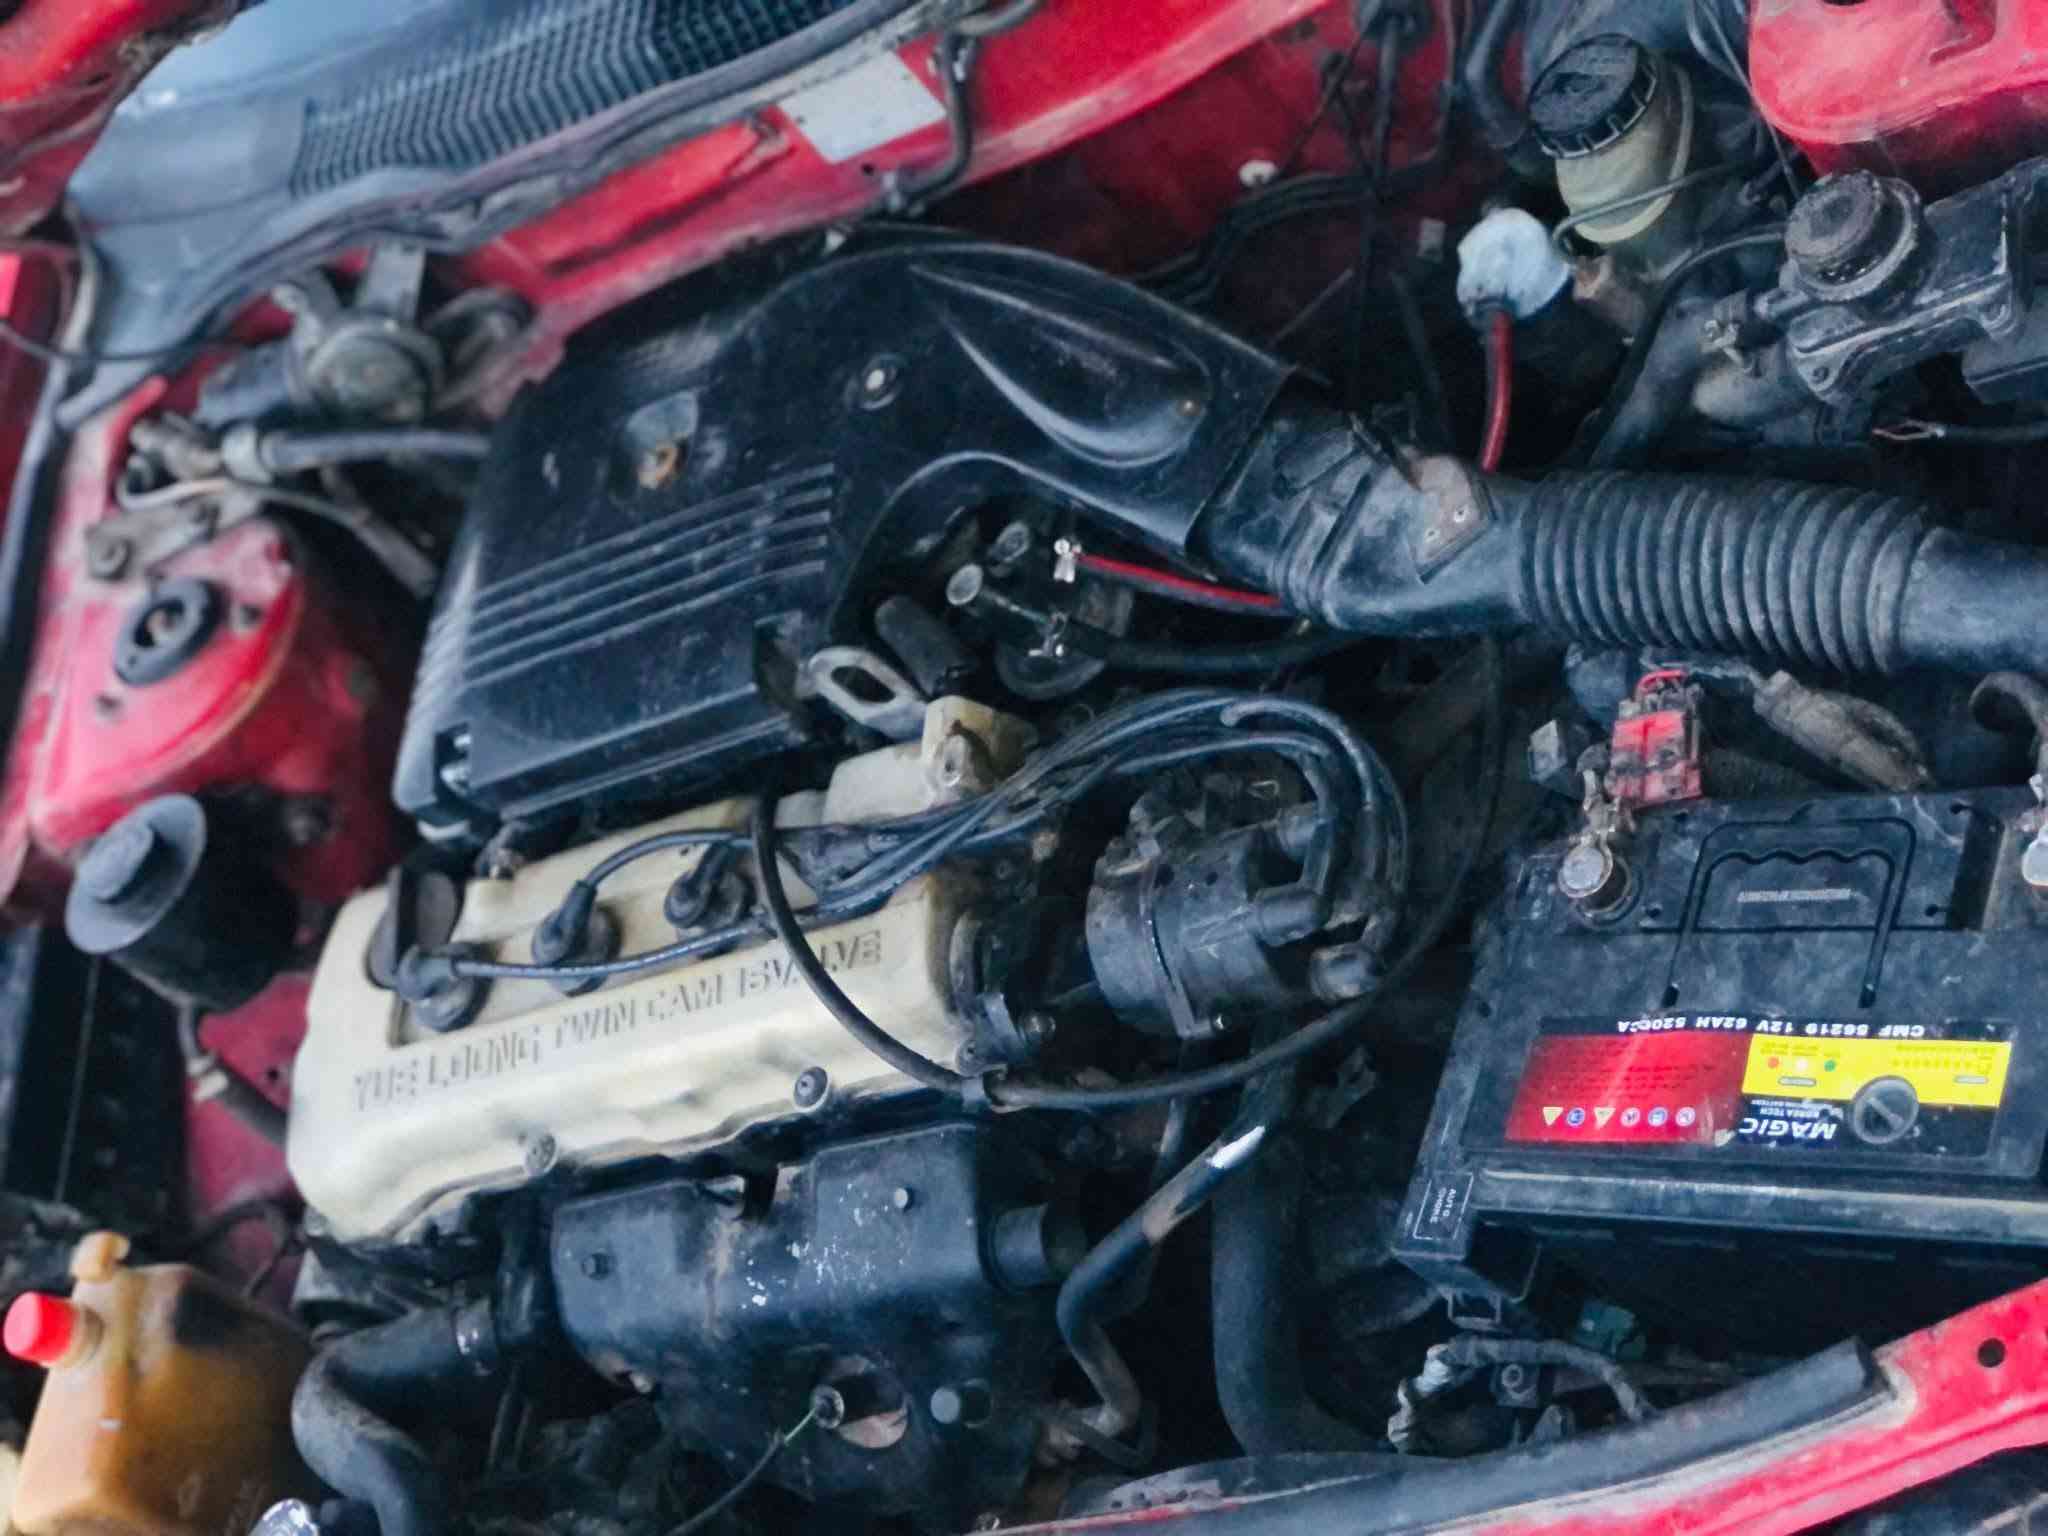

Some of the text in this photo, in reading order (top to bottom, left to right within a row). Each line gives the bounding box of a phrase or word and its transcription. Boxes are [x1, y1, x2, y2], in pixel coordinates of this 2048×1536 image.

[554, 998, 637, 1050] TWIN
[646, 972, 723, 1022] CAM
[1695, 1016, 1748, 1031] 62AH
[1755, 1019, 1793, 1034] 12V
[1878, 1024, 1925, 1037] CMF
[1738, 1118, 1837, 1139] MAGIC
